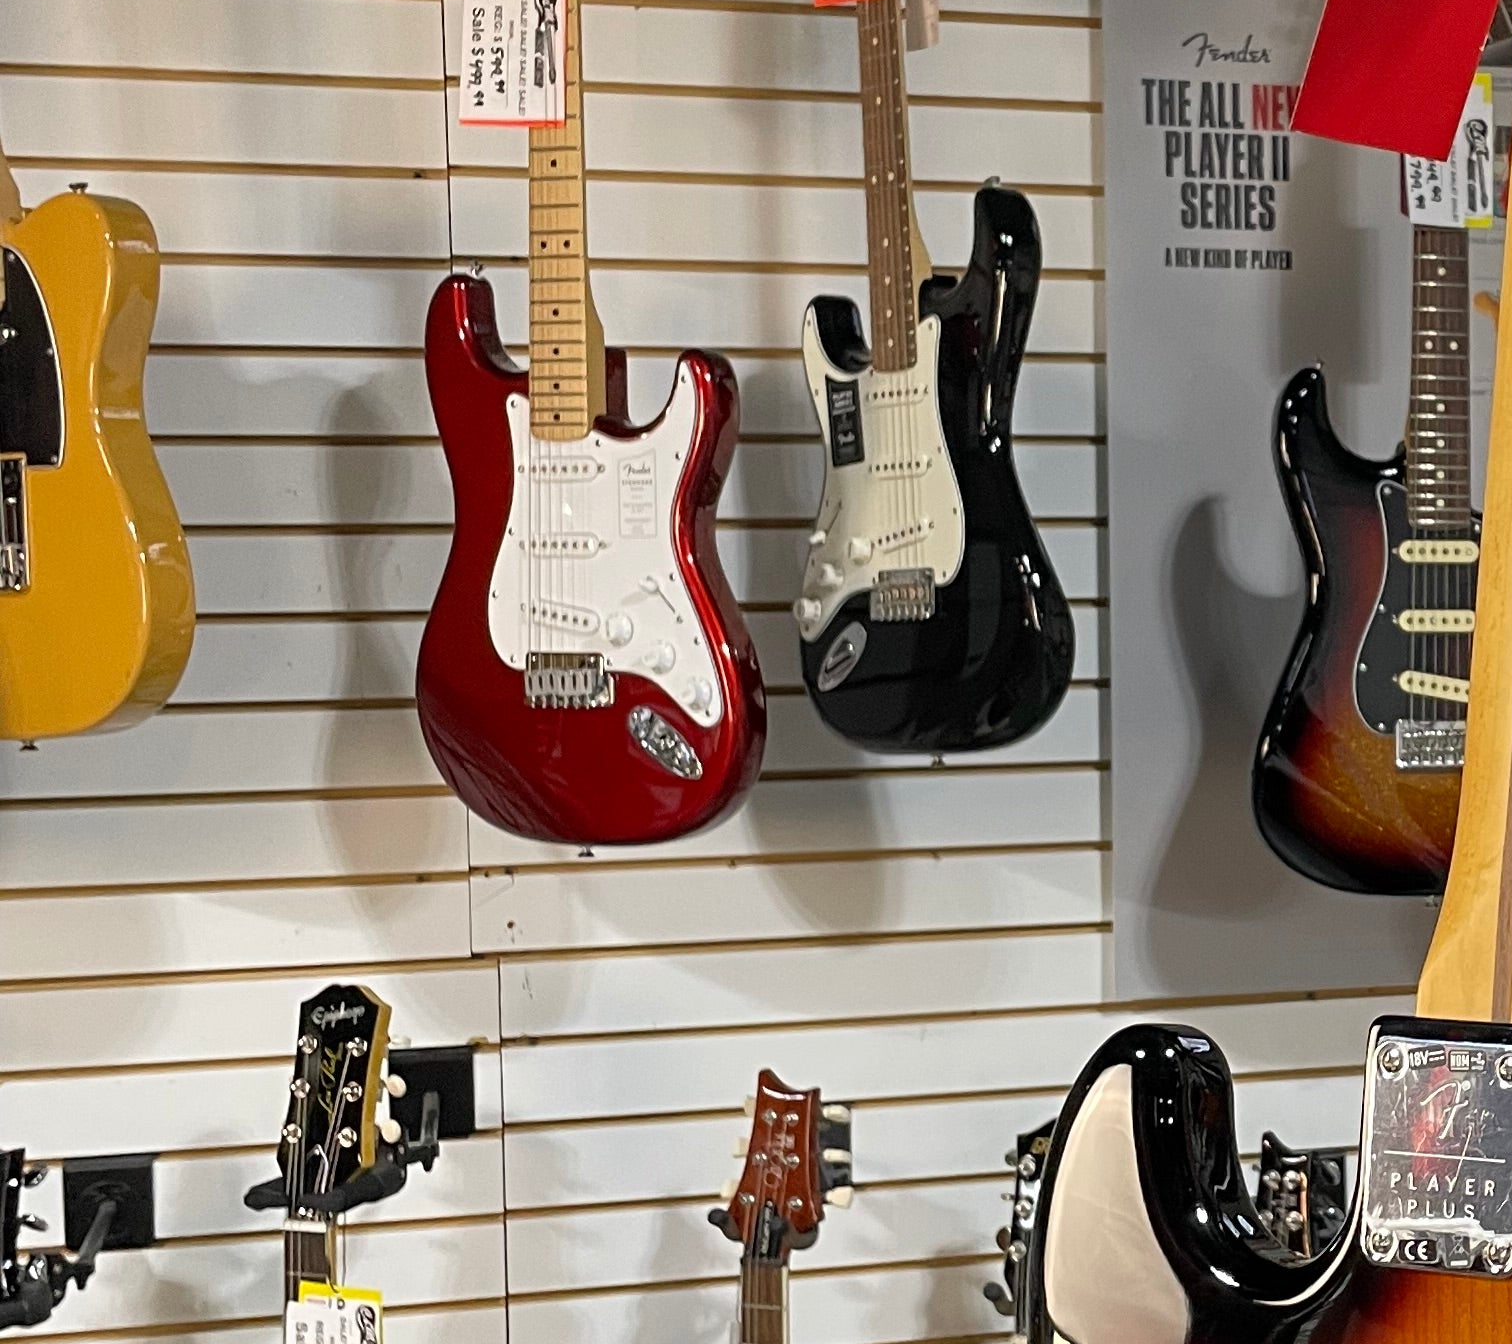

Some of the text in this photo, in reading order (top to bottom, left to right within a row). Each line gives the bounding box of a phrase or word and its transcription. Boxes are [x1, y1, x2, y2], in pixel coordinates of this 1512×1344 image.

[472, 8, 485, 42] Sale
[1182, 32, 1271, 67] Fender
[1142, 78, 1191, 127] THE
[1200, 82, 1244, 130] ALL
[1165, 131, 1290, 181] PLAYER II
[1181, 182, 1276, 231] SERIES
[1165, 247, 1293, 270] A NEW KIND OF PLAYER
[1390, 1172, 1496, 1197] PLAYER
[1407, 1198, 1476, 1220] PLUS
